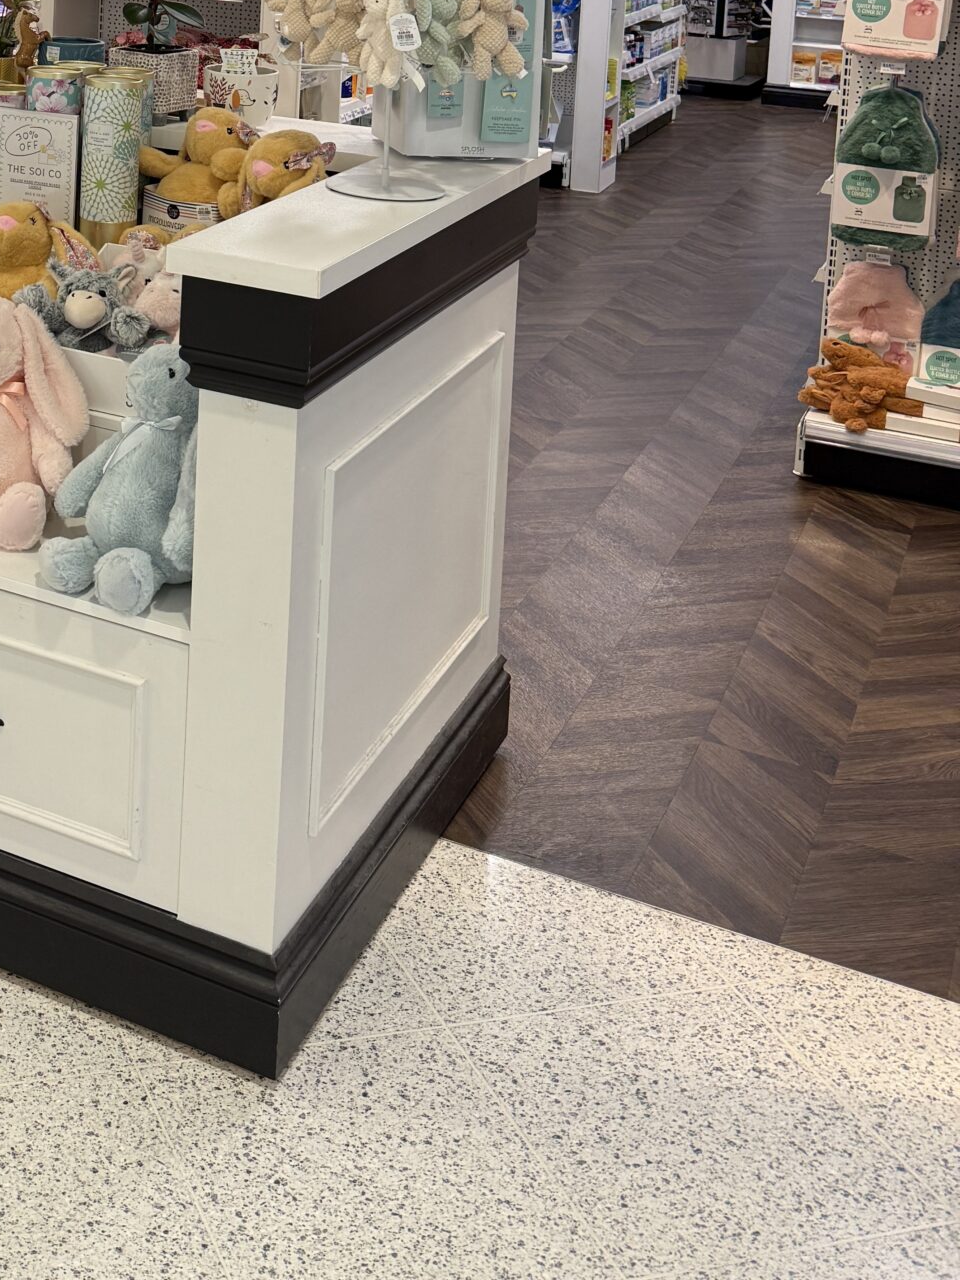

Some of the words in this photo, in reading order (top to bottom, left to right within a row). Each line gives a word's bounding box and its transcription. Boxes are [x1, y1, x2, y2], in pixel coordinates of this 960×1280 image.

[16, 130, 38, 141] 30%
[19, 141, 38, 151] OFF
[7, 164, 25, 175] THE
[29, 167, 45, 177] SOI
[48, 169, 62, 179] CO
